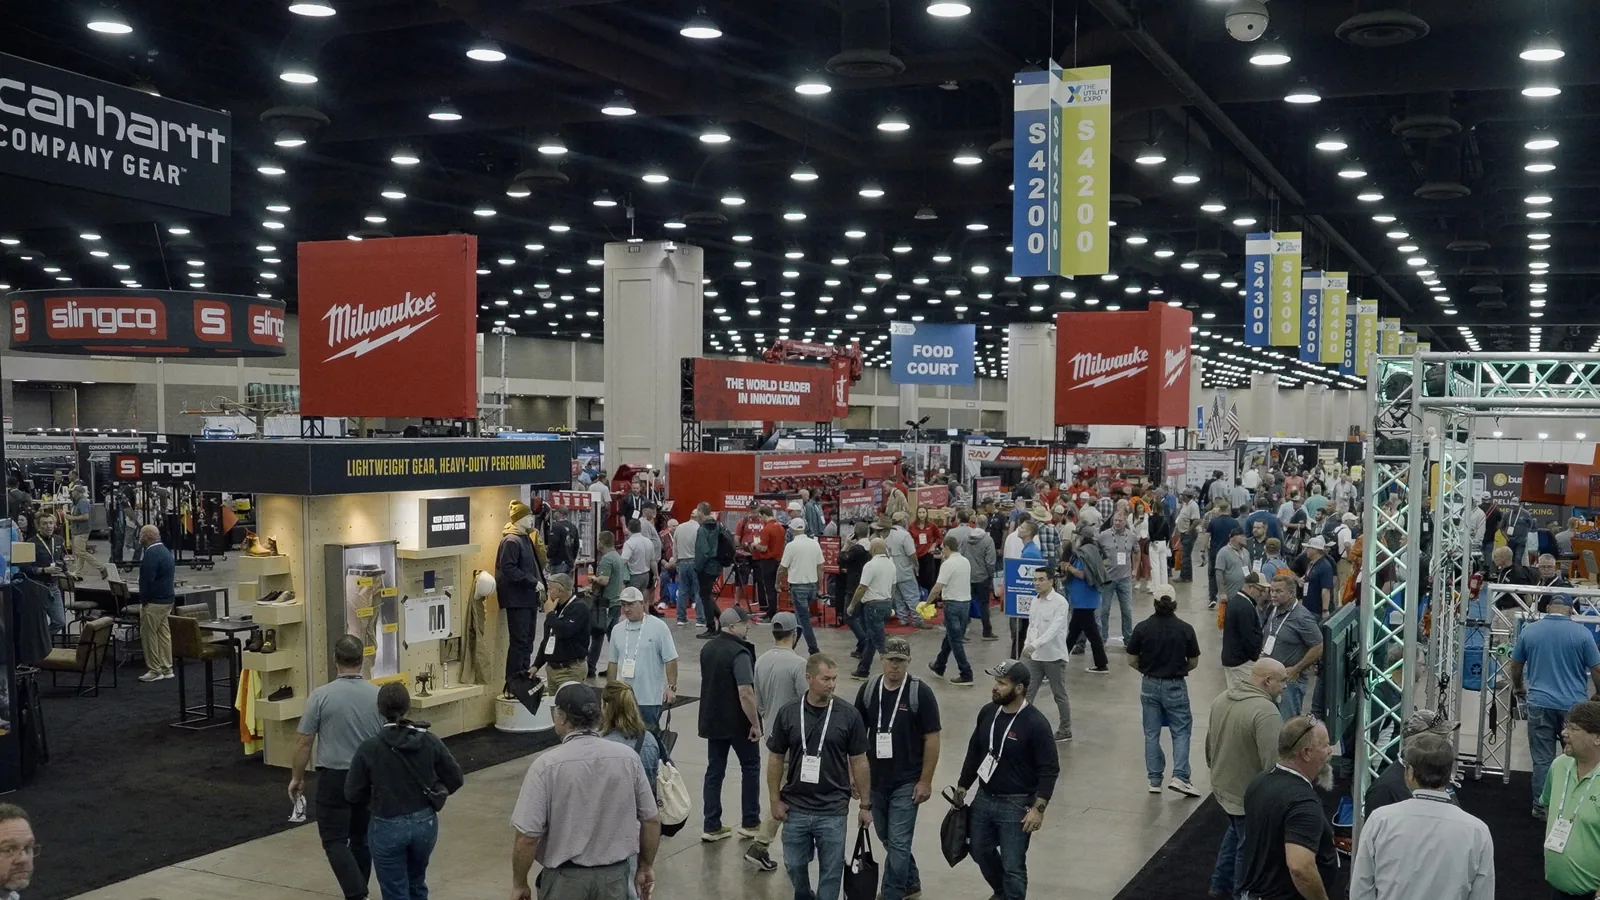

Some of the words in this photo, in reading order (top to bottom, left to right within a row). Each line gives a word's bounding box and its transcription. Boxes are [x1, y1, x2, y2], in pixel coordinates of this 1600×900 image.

[1083, 89, 1109, 97] UTILITY
[1083, 95, 1102, 103] EXPO
[0, 77, 226, 164] carhartt
[0, 123, 113, 170] COMPANY
[1027, 122, 1047, 254] S4200
[1076, 119, 1096, 253] S4200
[321, 292, 436, 348] Milwaukee
[1252, 260, 1265, 335] S4300
[1281, 260, 1294, 335] S4300
[1306, 294, 1318, 354] S4400
[1329, 294, 1341, 354] S4400
[1344, 318, 1353, 368] S4500
[906, 362, 960, 376] COURT
[912, 344, 954, 358] FOOD
[725, 376, 745, 390] THE
[745, 378, 778, 392] WORLD
[778, 380, 811, 394] LEADER
[738, 392, 748, 404] IN
[750, 392, 801, 406] INNOVATION
[346, 458, 410, 477] LIGHTWEIGHT
[412, 457, 438, 476] GEAR,
[439, 456, 490, 474] HEAVY-DUTY
[490, 454, 546, 472] PERFORMANCE
